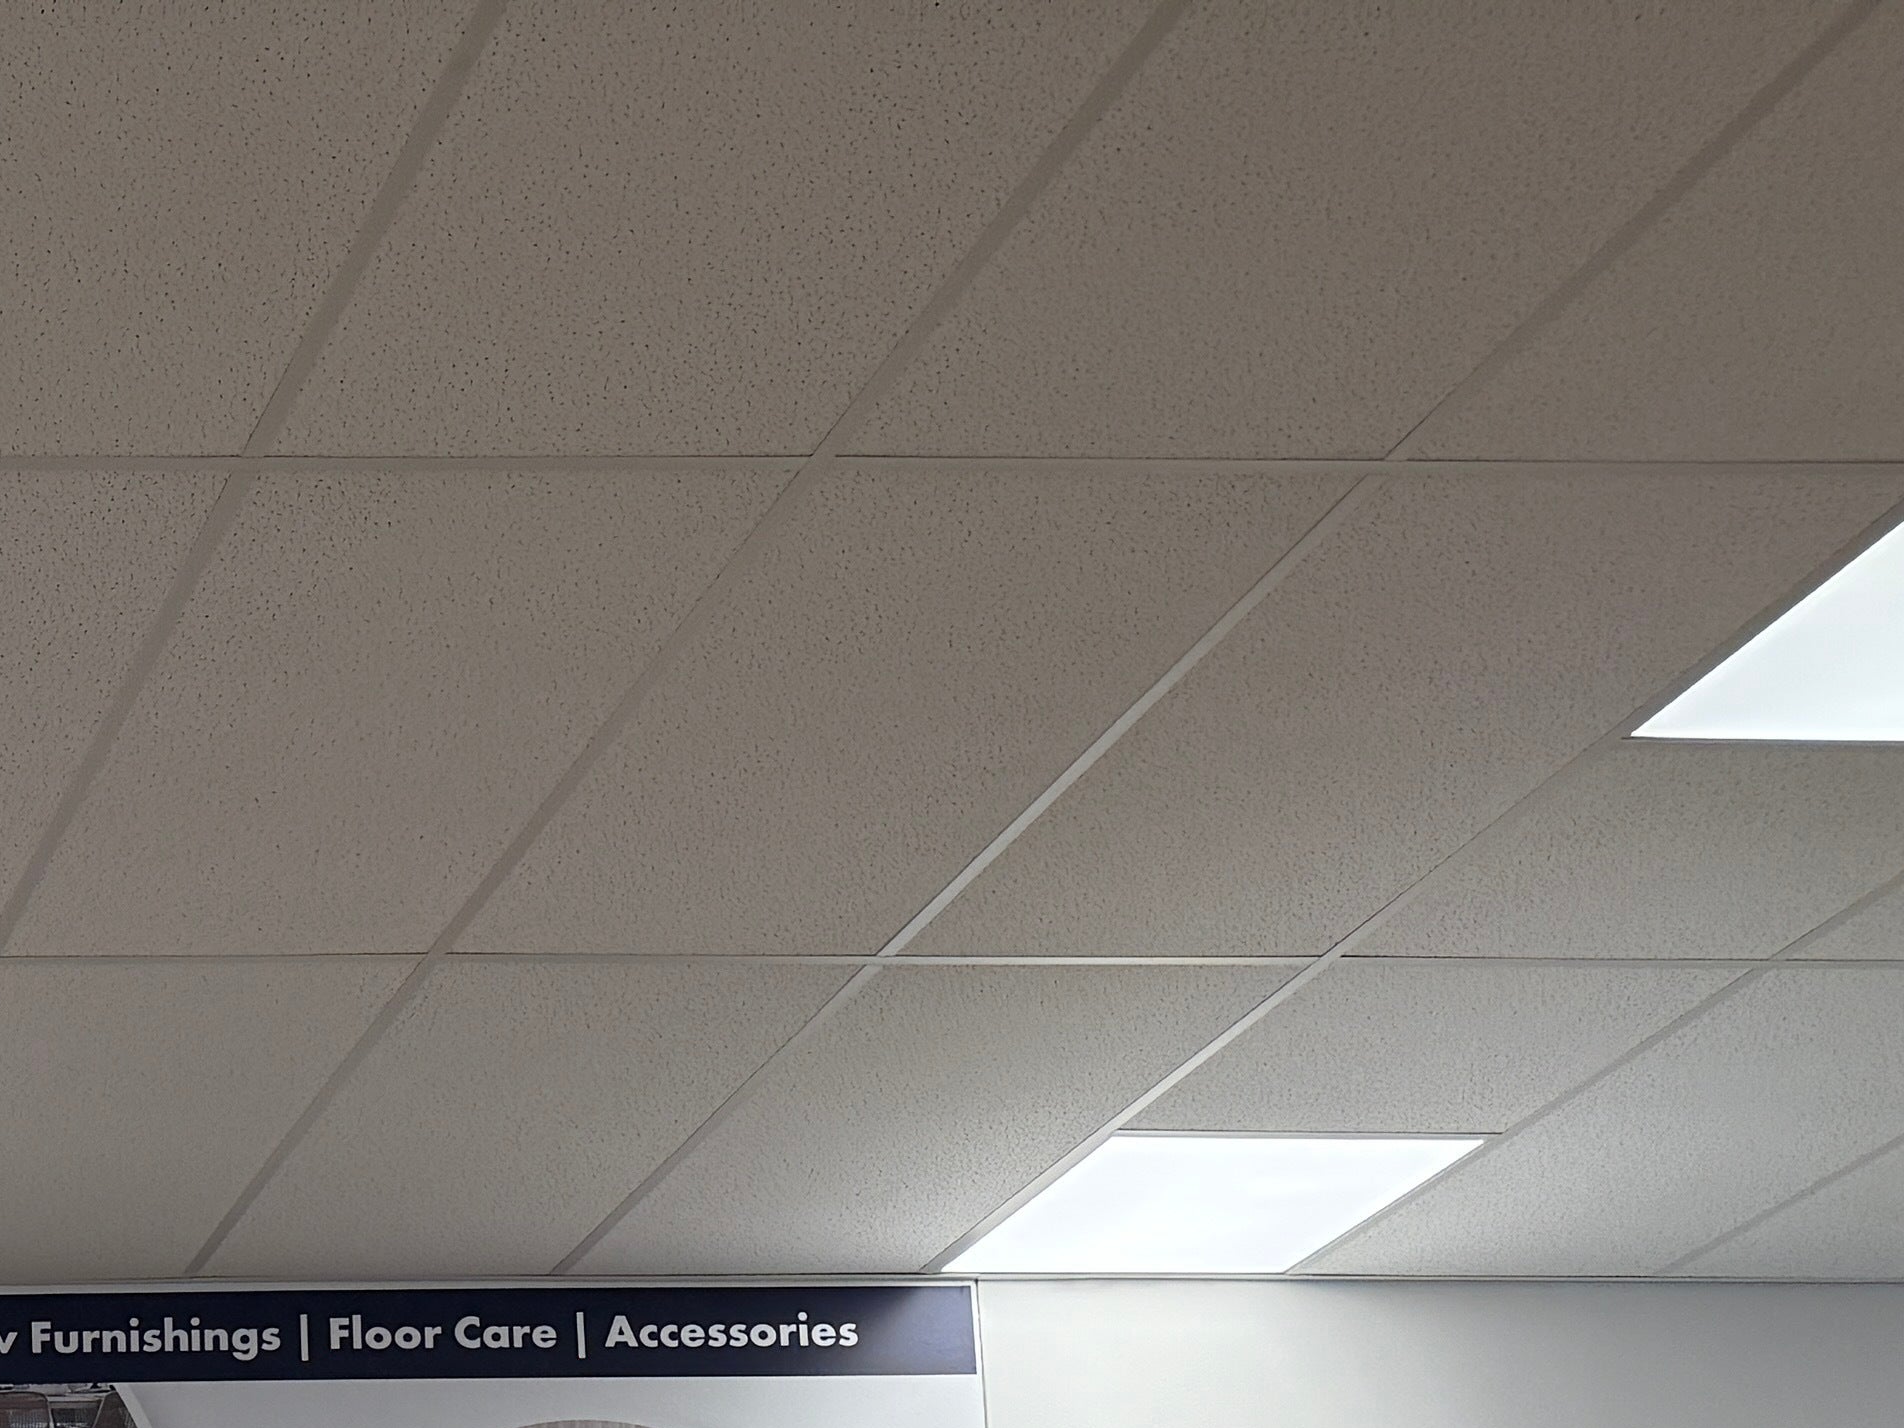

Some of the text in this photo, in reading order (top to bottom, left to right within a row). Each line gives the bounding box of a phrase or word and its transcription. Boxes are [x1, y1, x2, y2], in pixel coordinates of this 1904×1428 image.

[31, 1317, 282, 1362] Furnishings
[329, 1314, 442, 1350] Floor
[454, 1315, 559, 1349] Care
[604, 1312, 860, 1349] Accessories
